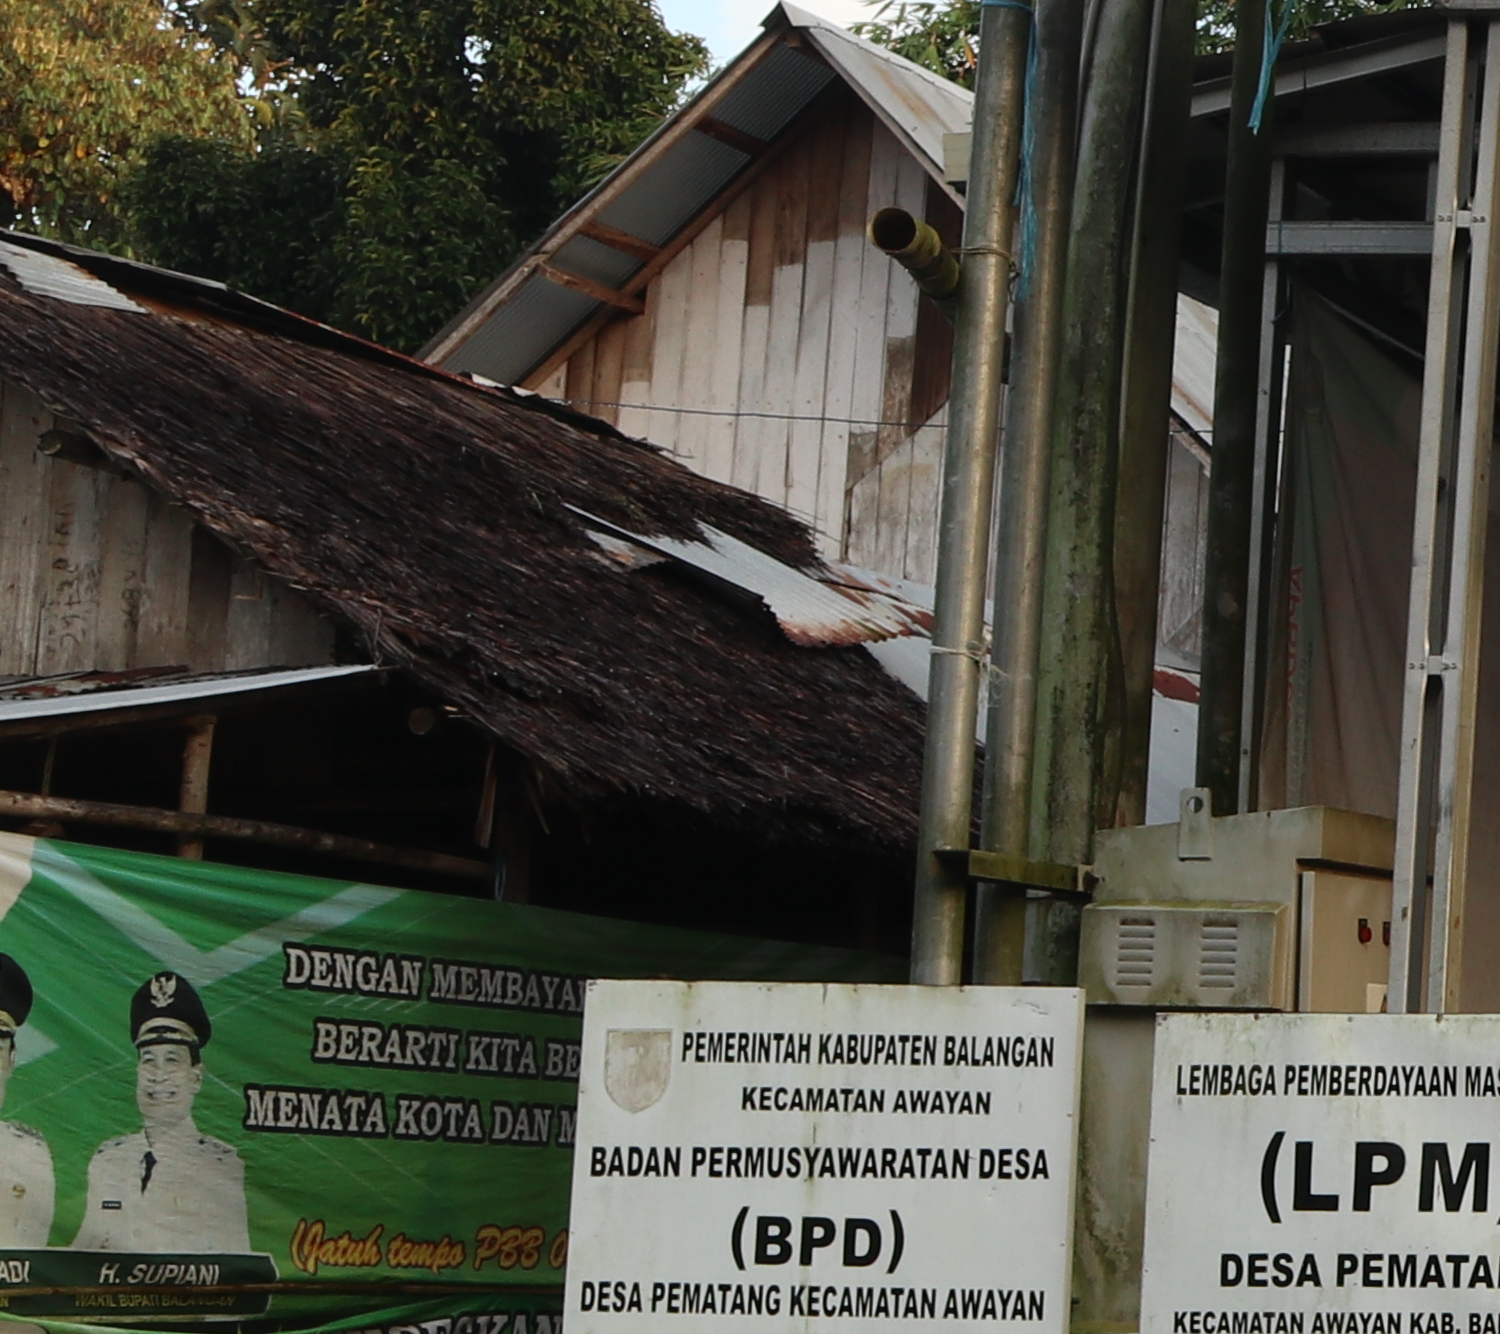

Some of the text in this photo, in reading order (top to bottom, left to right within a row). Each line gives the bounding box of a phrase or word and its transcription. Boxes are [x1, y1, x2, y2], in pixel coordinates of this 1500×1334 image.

[285, 947, 422, 996] DENGAN
[315, 1022, 459, 1069] BERARTI
[466, 1036, 537, 1075] KITA
[682, 1033, 1054, 1068] PEMERINTAH KABUPATEN BALANGAN
[1177, 1065, 1277, 1096] LEMBAGA
[1283, 1066, 1458, 1097] PEMBERDAYAAN
[245, 1087, 386, 1134] MENATA
[395, 1099, 482, 1138] KOTA
[492, 1106, 551, 1141] DAN
[742, 1086, 991, 1114] KECAMATAN AWAYAN
[590, 1146, 1049, 1180] BADAN PERMUSYAWARATAN DESA
[731, 1206, 904, 1274] (BPD)
[99, 1263, 219, 1285] H. SUPIANI
[1220, 1253, 1322, 1288] DESA
[581, 1281, 1044, 1320] DESA PEMATANG KECAMATAN AWAYAN
[1174, 1312, 1304, 1334] KECAMATAN
[1311, 1313, 1401, 1334] AWAYAN
[1409, 1313, 1462, 1334] KAB.
